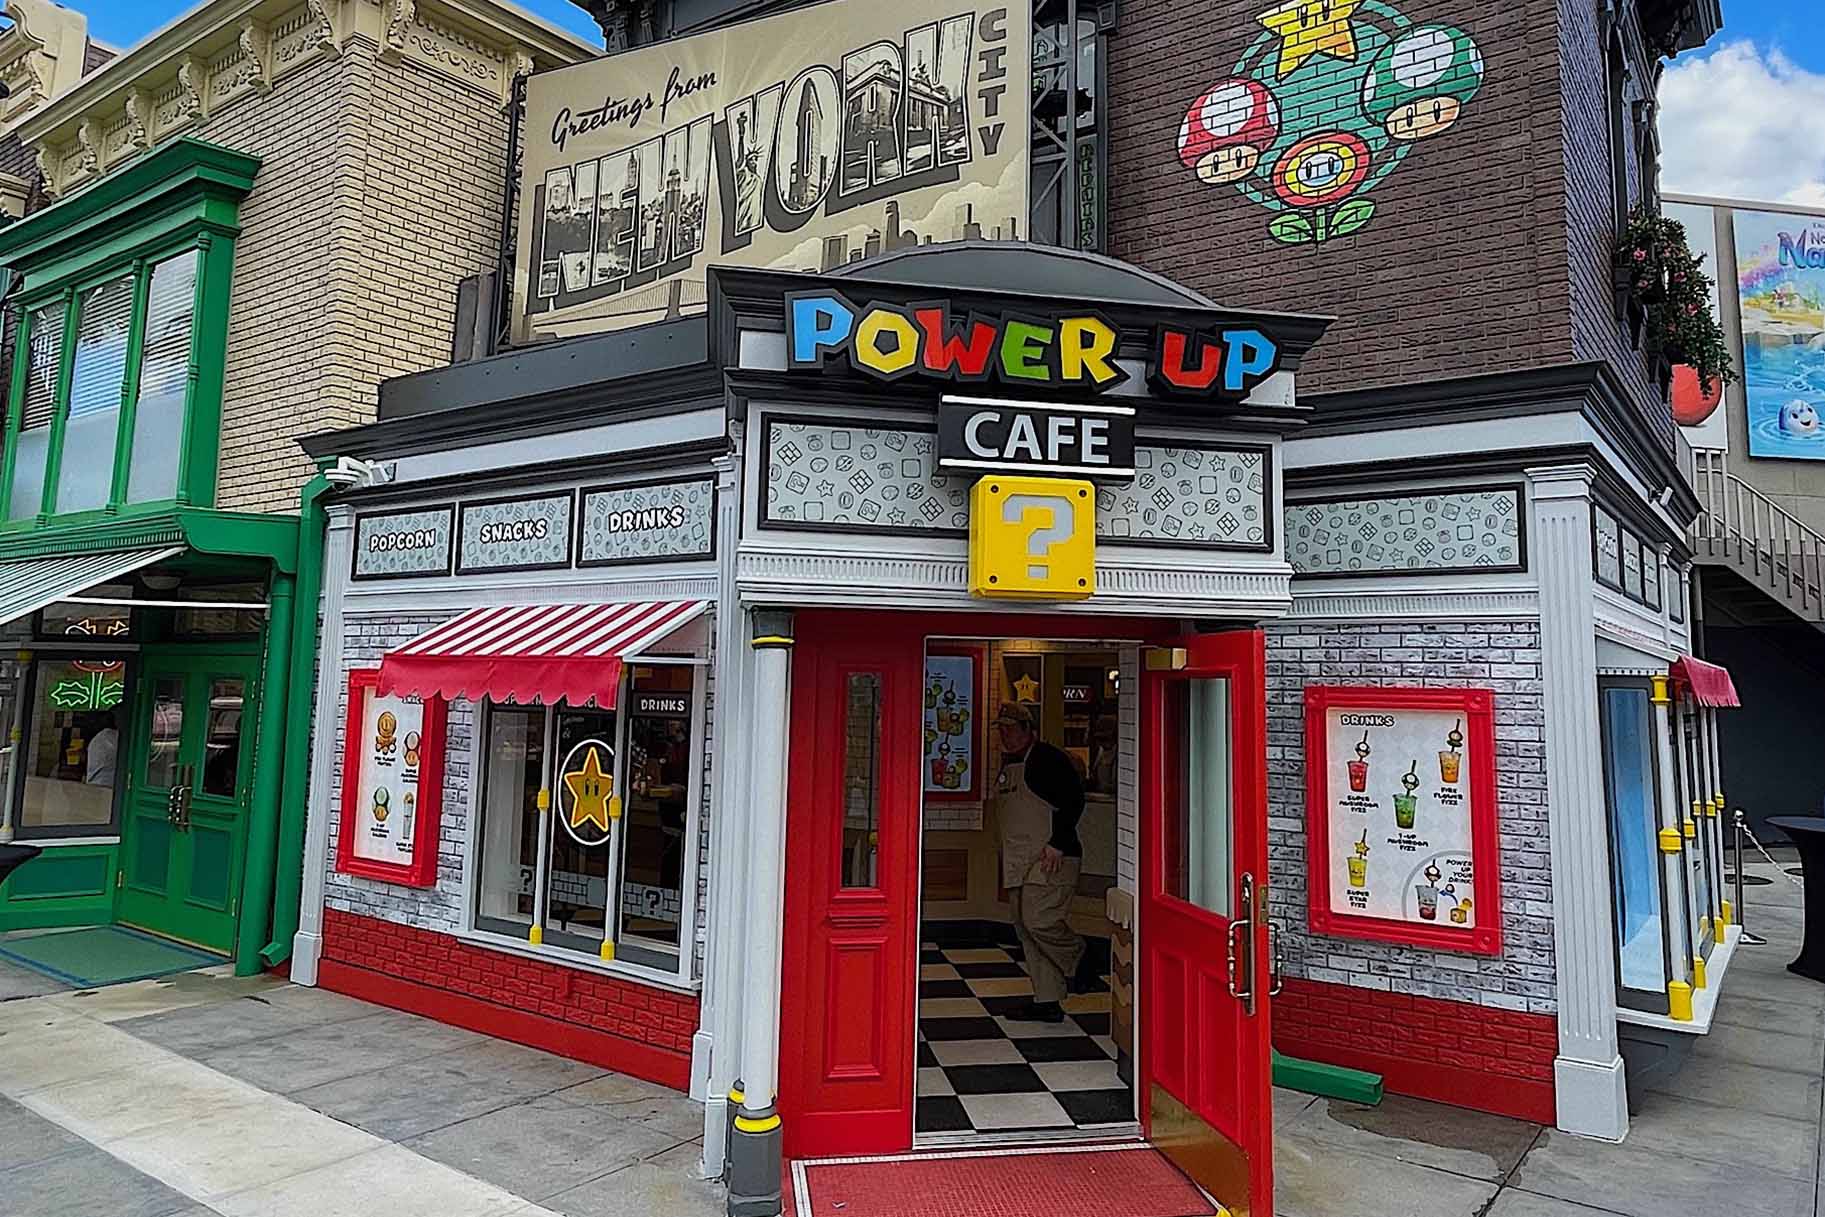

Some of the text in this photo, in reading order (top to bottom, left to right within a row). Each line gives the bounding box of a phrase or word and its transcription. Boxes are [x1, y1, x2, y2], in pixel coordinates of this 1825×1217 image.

[977, 8, 1007, 156] CITY
[551, 66, 717, 152] Greetings from
[537, 12, 975, 300] NEW YORK
[790, 294, 1279, 391] POWER UP
[964, 410, 1109, 464] CAFE
[369, 528, 436, 552] POPCORN
[480, 518, 547, 544] SNACKS
[608, 505, 685, 534] DRINKS
[640, 698, 685, 712] DRINKS
[1340, 713, 1395, 727] DRINKS
